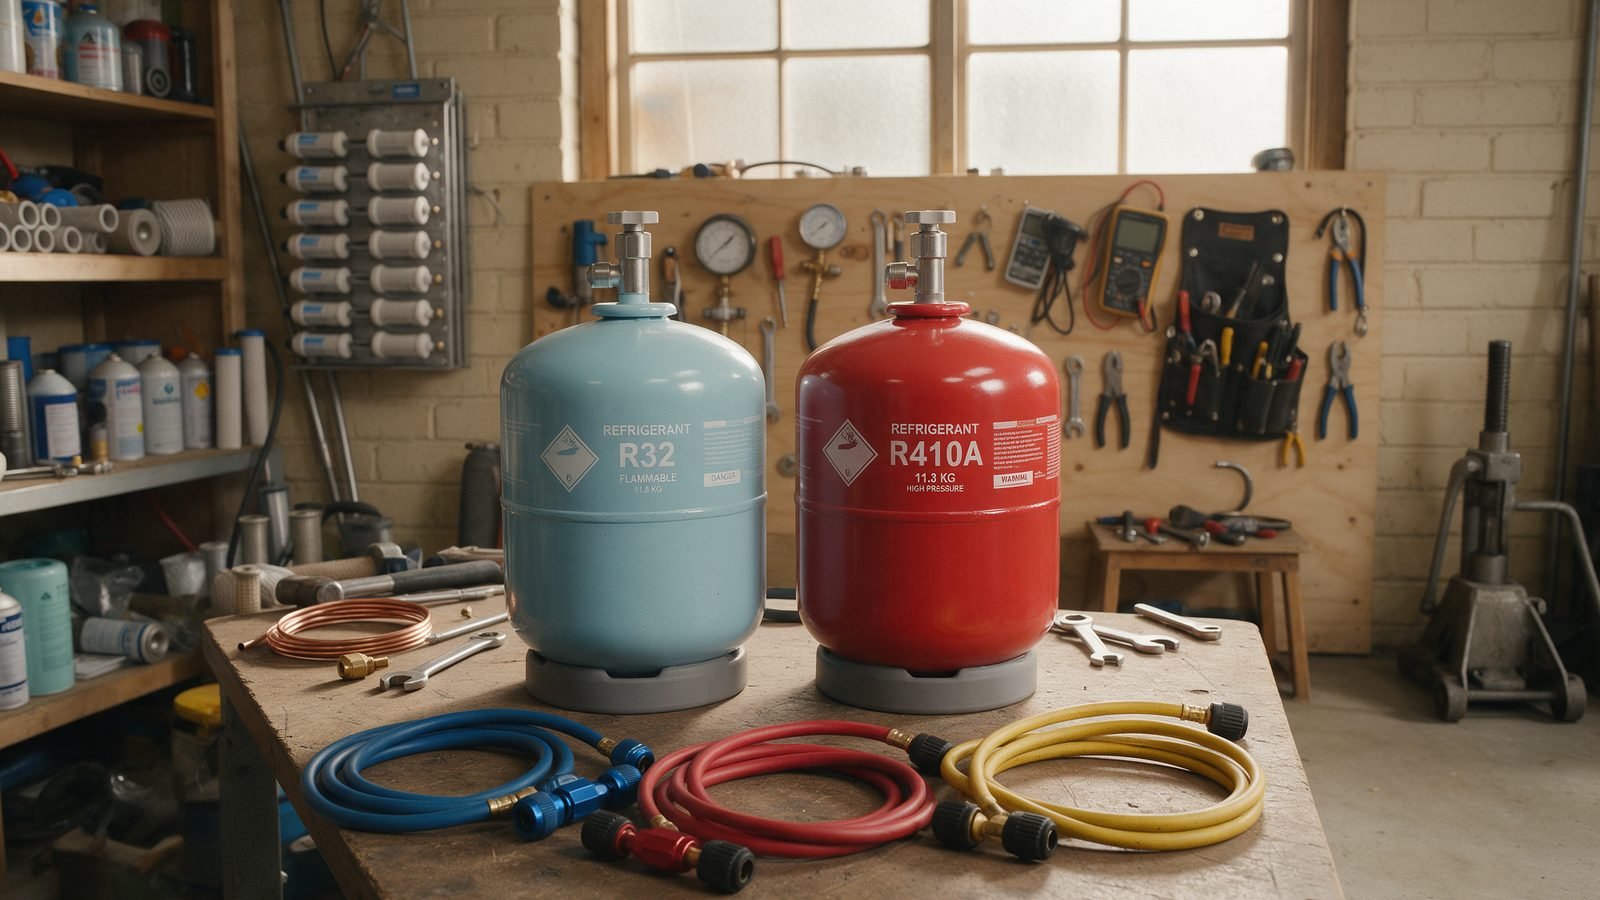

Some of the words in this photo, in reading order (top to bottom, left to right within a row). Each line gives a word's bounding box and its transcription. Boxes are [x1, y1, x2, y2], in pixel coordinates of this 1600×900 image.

[603, 424, 691, 436] REFRIGERANT
[891, 423, 980, 435] REFRIGERANT
[619, 441, 675, 467] R32
[890, 441, 983, 467] R410A
[619, 473, 677, 483] FLAMMABLE
[915, 472, 937, 483] 11.3
[940, 472, 956, 483] KG
[651, 485, 662, 493] KG
[906, 484, 925, 493] HIGH
[926, 484, 964, 493] PRESSURE
